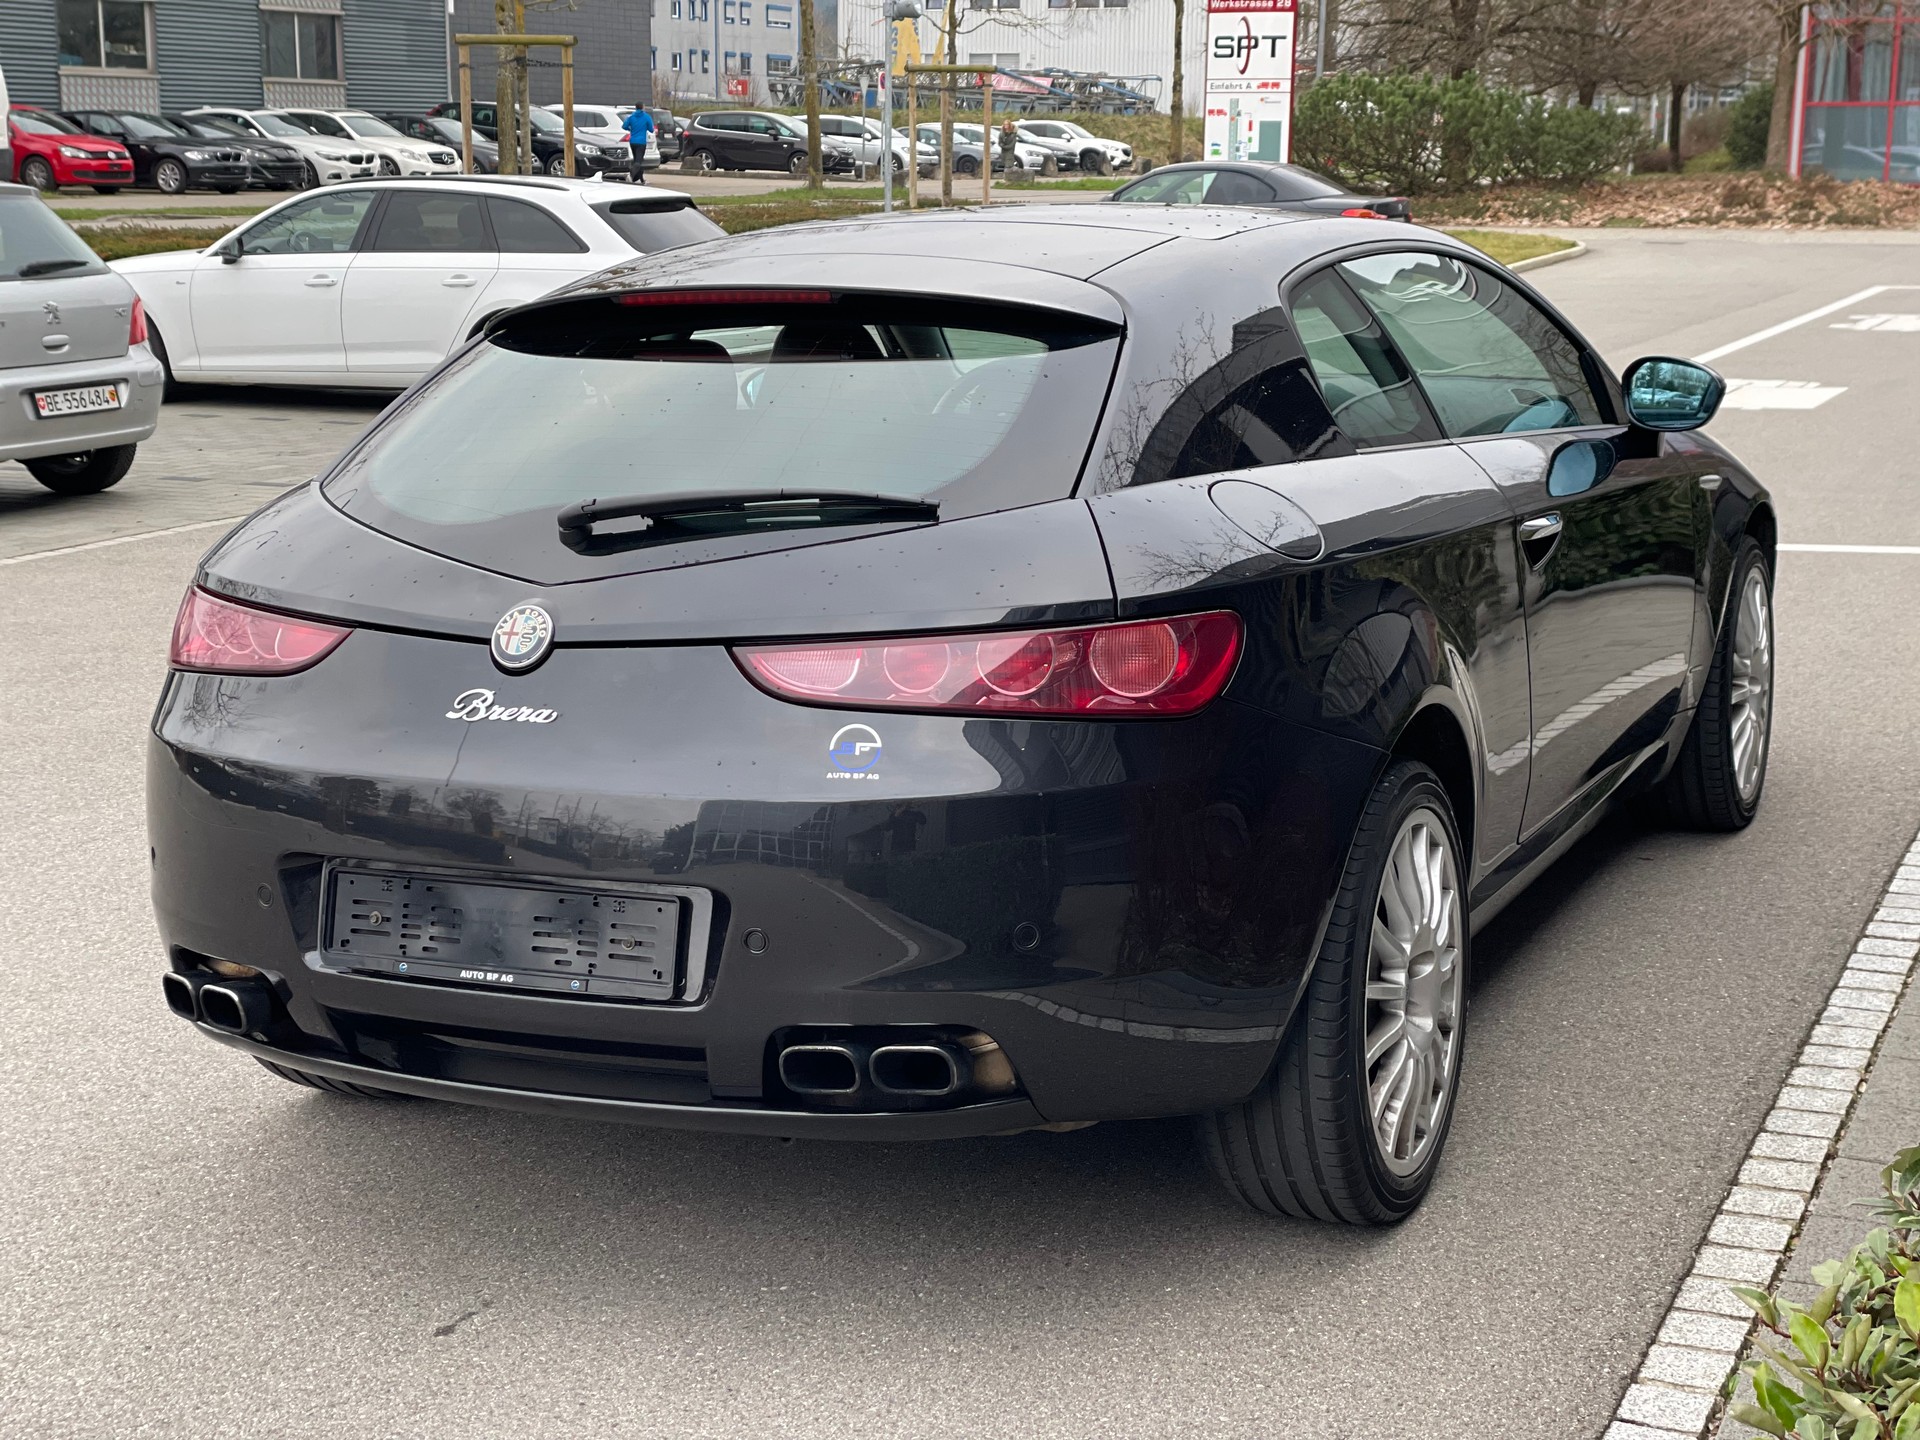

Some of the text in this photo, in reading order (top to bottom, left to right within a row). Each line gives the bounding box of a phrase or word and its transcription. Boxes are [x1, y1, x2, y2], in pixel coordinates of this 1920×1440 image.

[1211, 0, 1274, 8] Werkstrasse
[1213, 35, 1288, 58] SPT
[1209, 82, 1252, 90] Einfahrt A
[496, 608, 546, 638] ALFA ROMEO
[445, 688, 558, 723] Brera
[460, 970, 514, 983] AUTO BP AG
